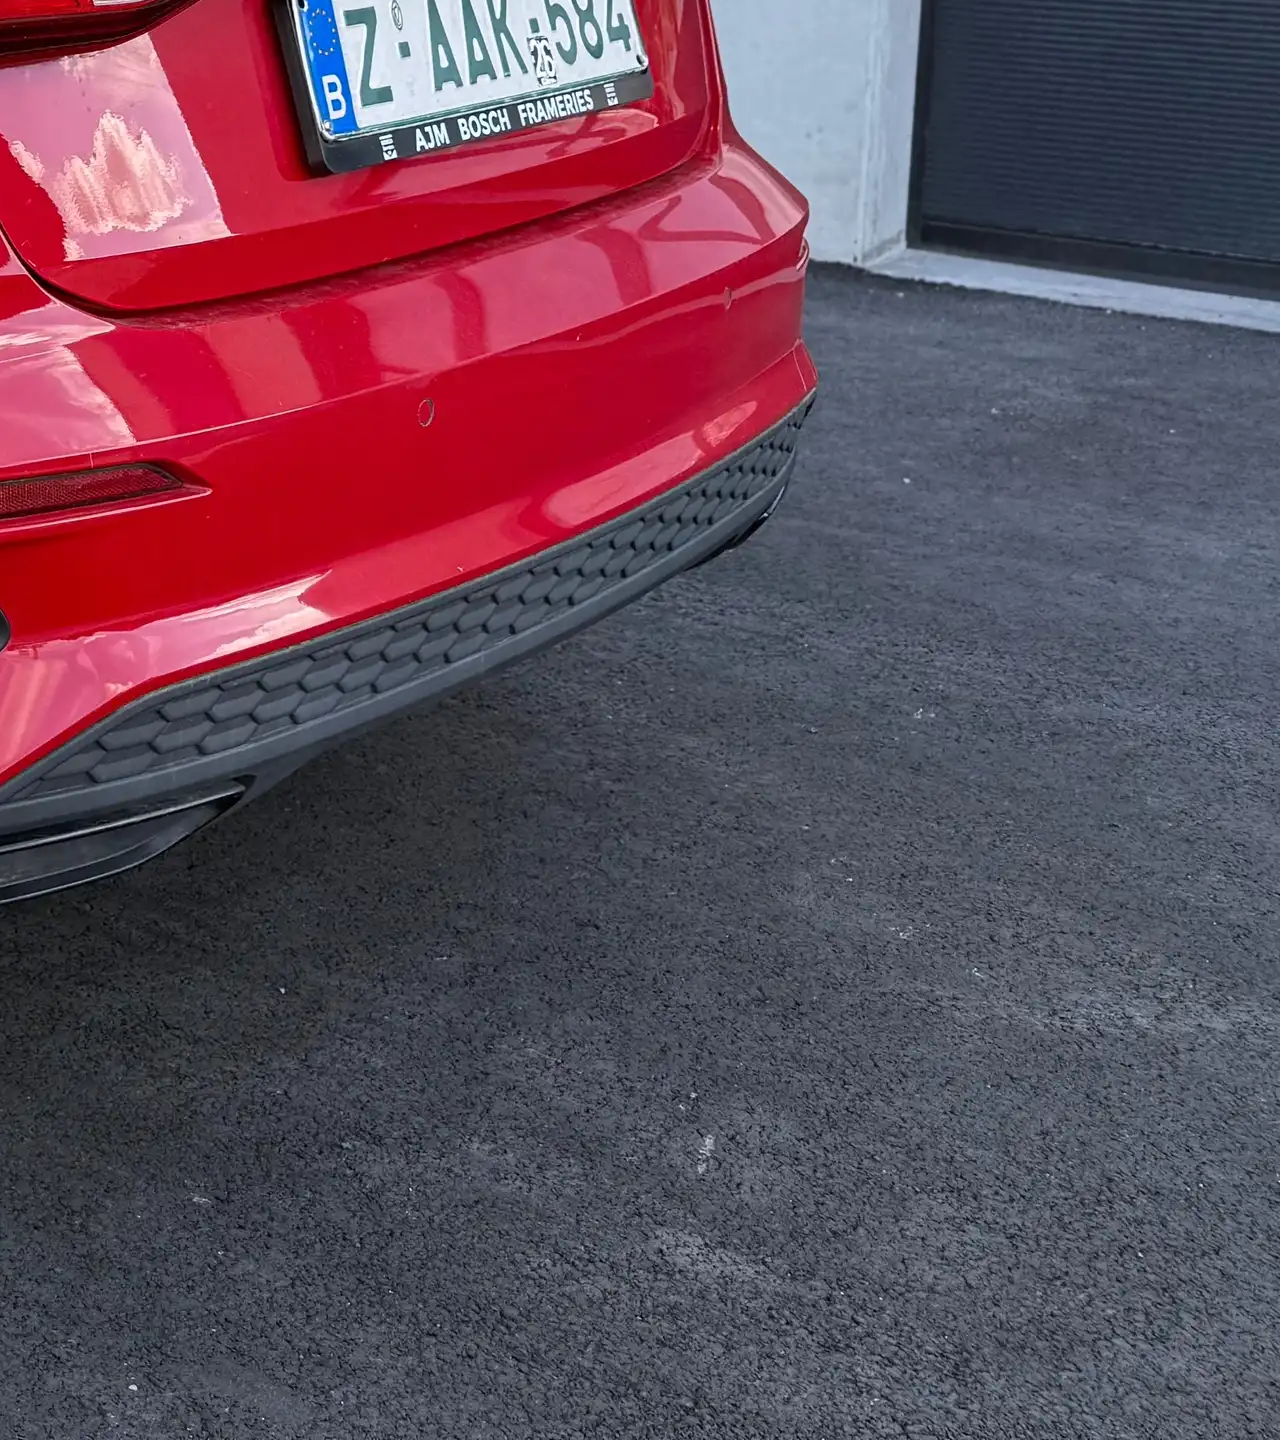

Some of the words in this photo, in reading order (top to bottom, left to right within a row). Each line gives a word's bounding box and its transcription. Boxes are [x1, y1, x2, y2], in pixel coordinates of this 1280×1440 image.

[322, 74, 346, 120] B
[415, 123, 450, 152] AJM
[457, 109, 512, 141] BOSCH
[517, 89, 594, 127] FRAMERIES
